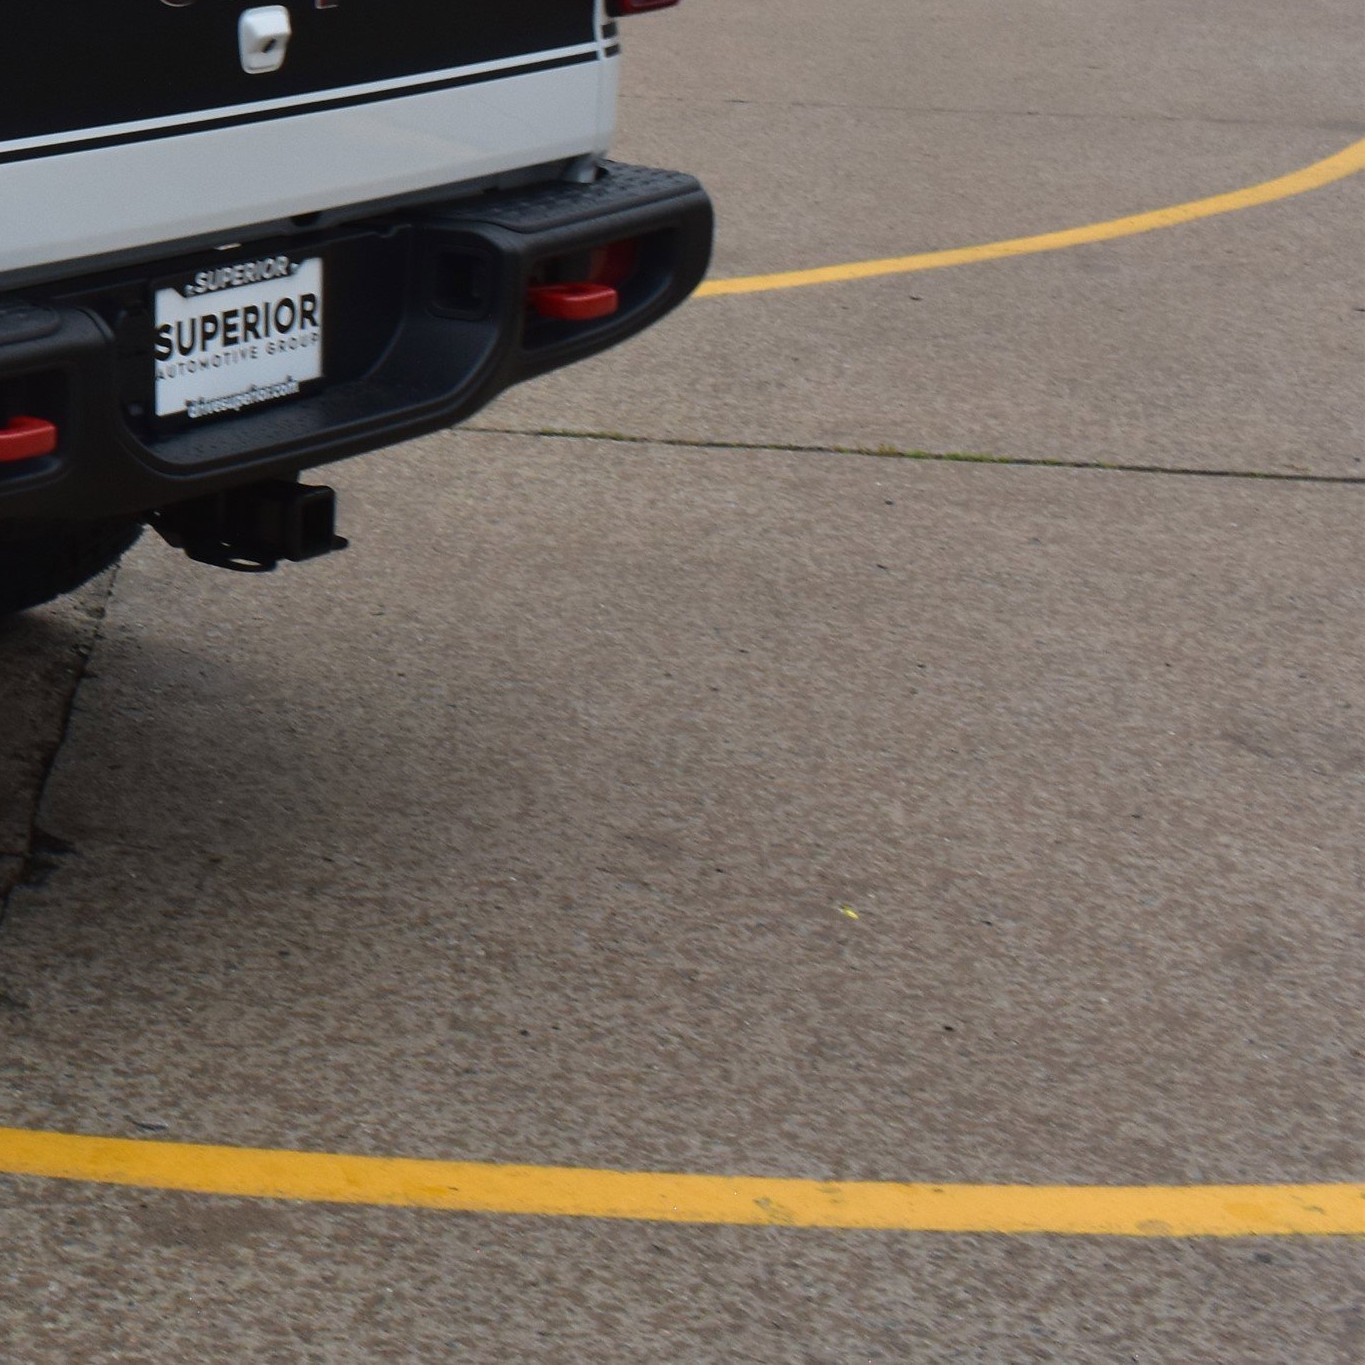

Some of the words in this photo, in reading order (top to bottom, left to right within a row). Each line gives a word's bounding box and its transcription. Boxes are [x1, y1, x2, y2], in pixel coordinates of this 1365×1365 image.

[194, 255, 290, 294] SUPERIOR
[153, 292, 319, 362] SUPERIOR
[155, 345, 259, 381] AUTOMOTIVE
[266, 332, 320, 356] GROUP
